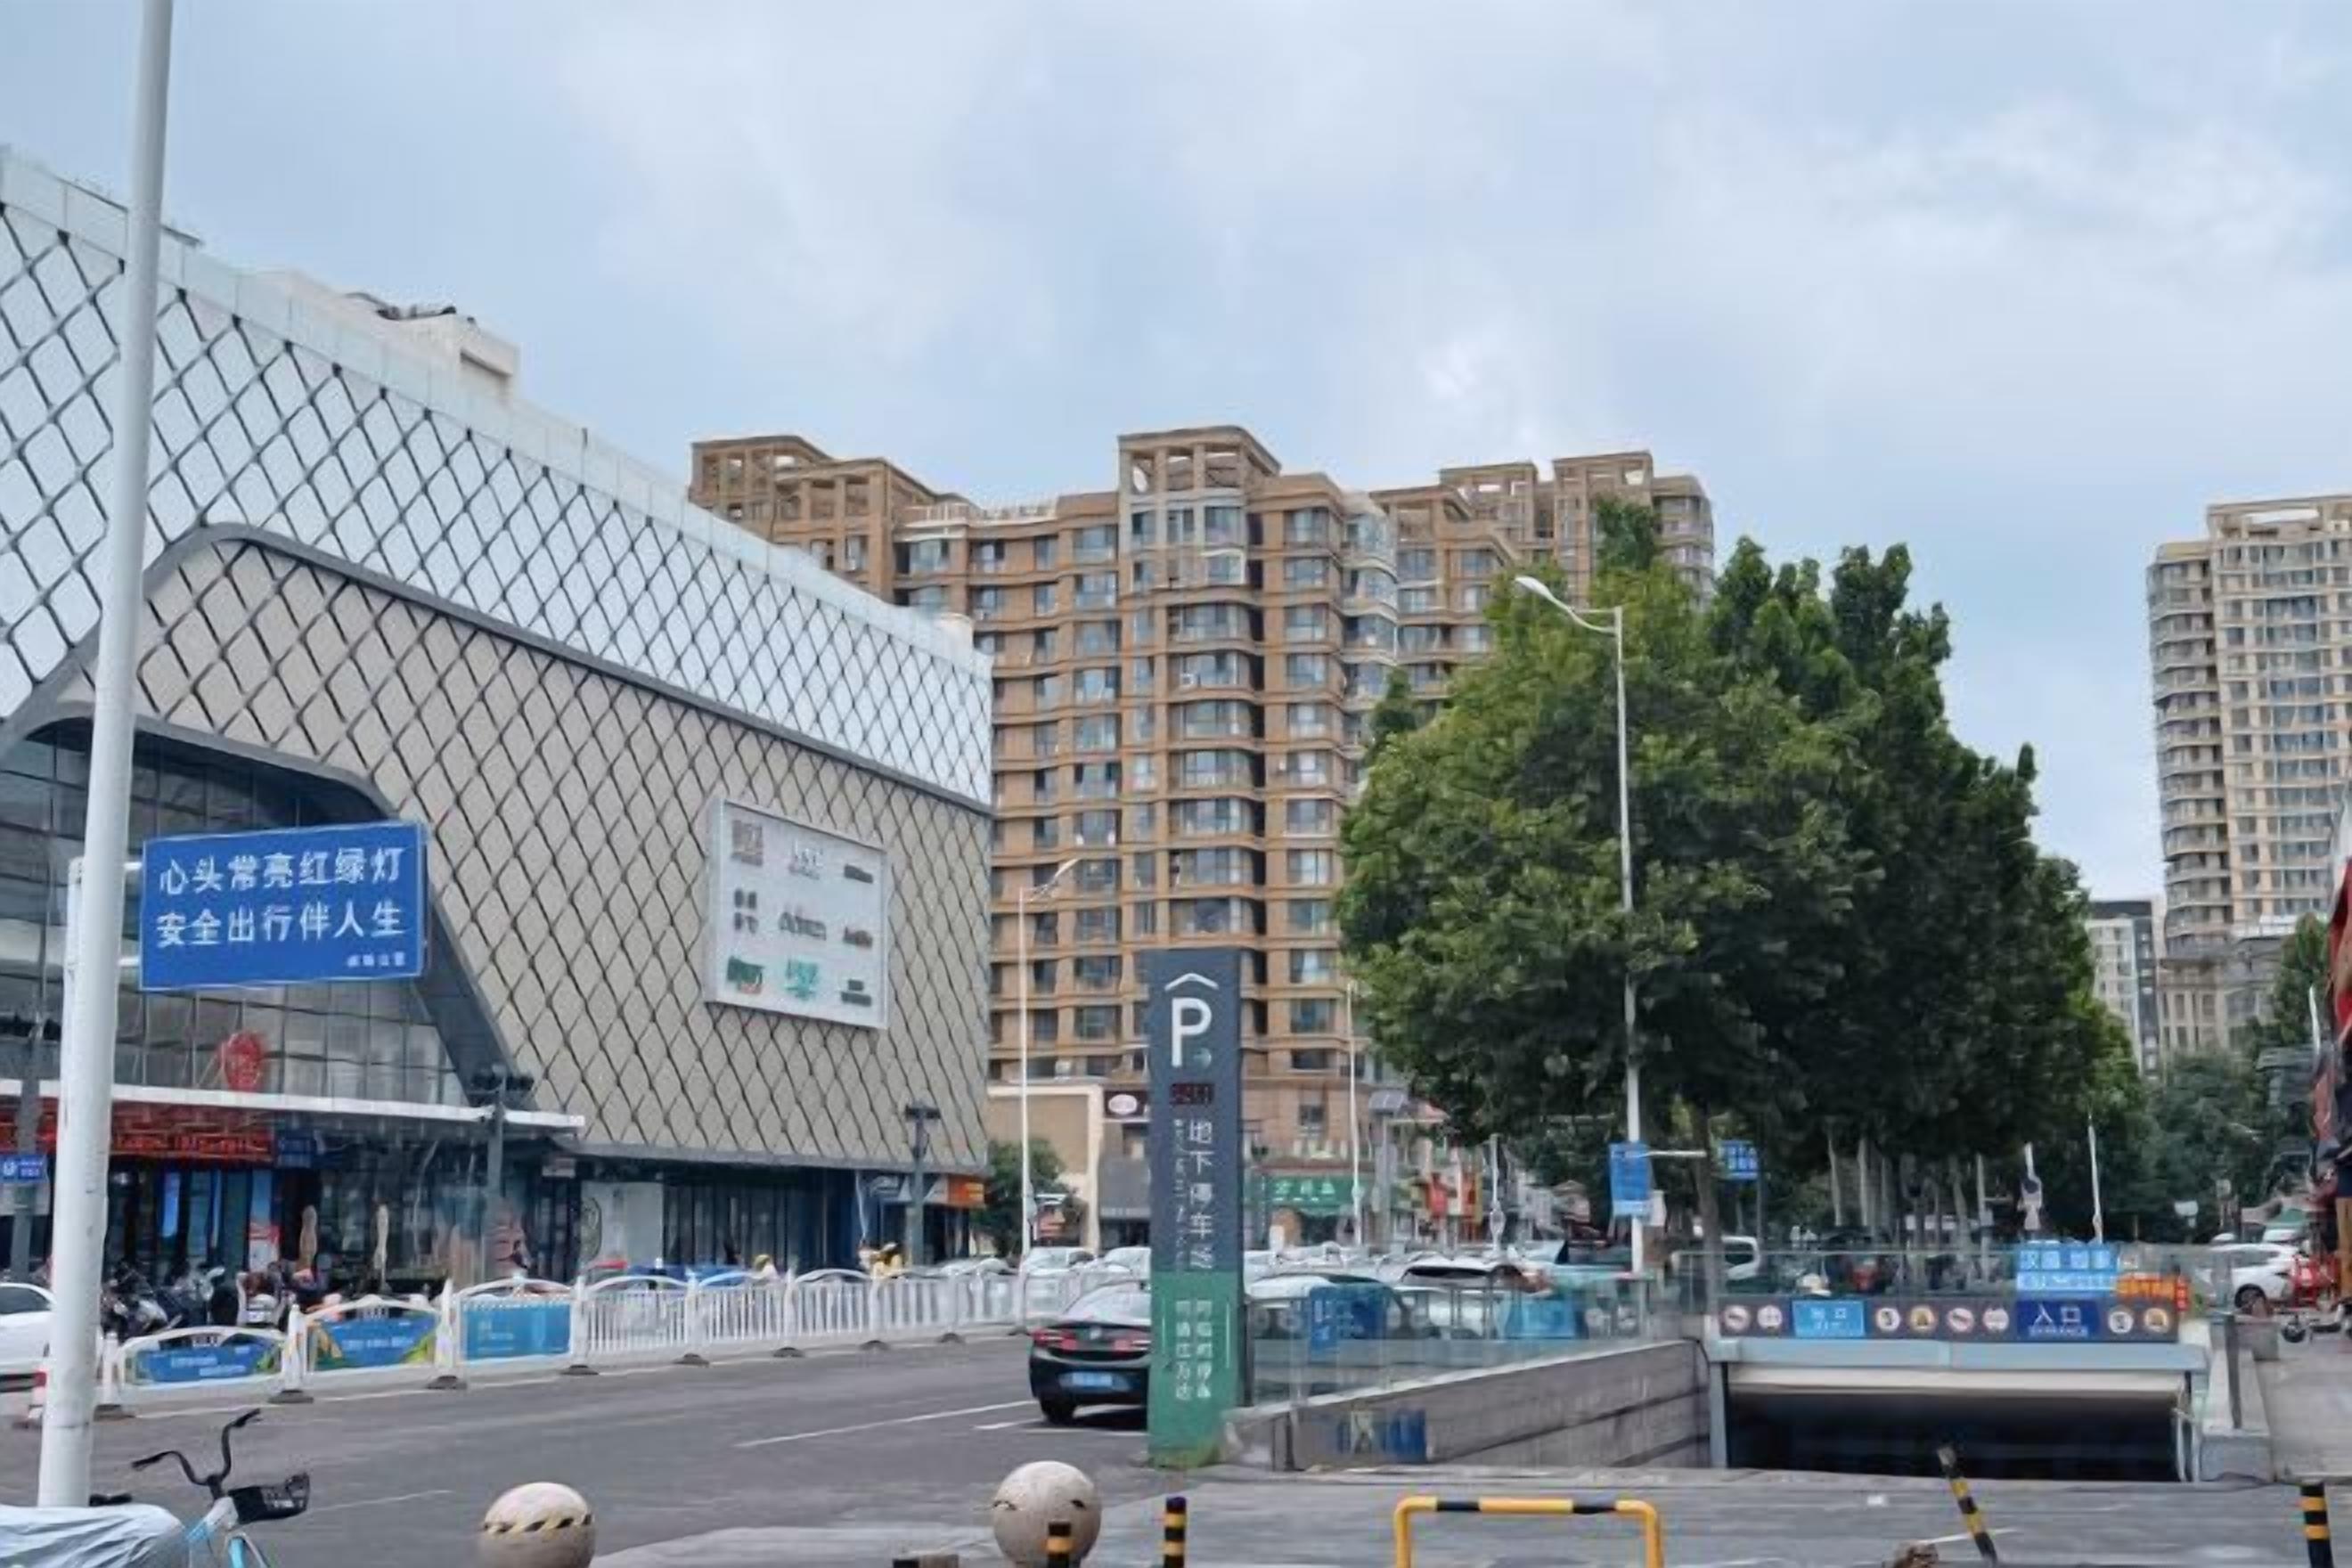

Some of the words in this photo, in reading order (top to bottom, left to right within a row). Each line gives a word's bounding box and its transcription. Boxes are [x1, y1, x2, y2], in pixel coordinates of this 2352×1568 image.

[159, 846, 405, 895] 心头常亮红绿灯
[155, 898, 407, 949] 安全出行伴人生
[1172, 997, 1213, 1067] P
[2033, 1302, 2082, 1328] 入口
